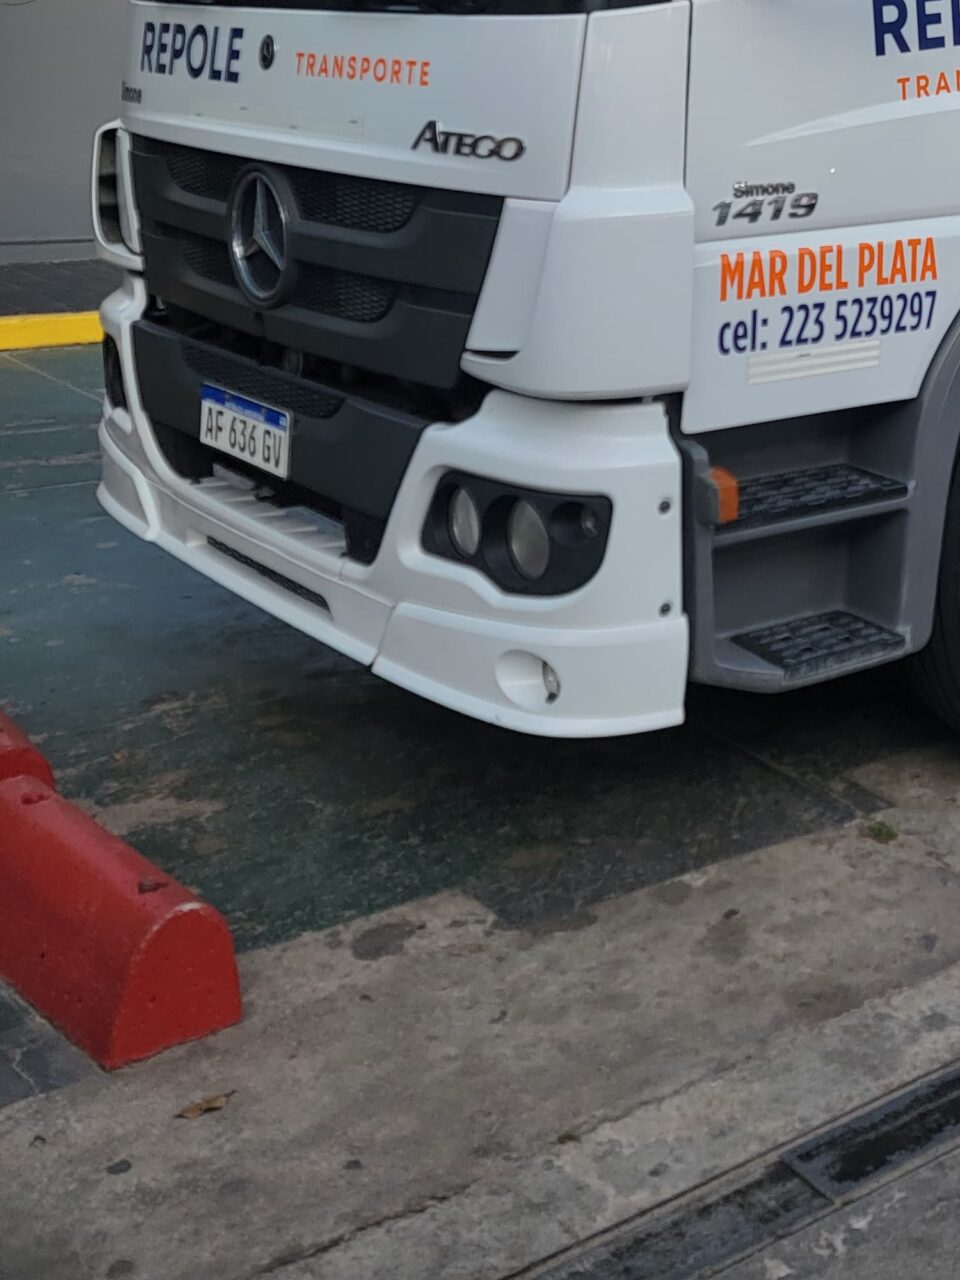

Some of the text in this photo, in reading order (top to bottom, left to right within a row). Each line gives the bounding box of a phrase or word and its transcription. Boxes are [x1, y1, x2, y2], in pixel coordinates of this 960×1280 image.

[140, 21, 431, 87] REPOLE TRANSPORTE
[712, 192, 819, 227] 1419
[733, 181, 796, 199] Simone
[719, 237, 938, 303] MAR DEL PLATA
[718, 290, 938, 356] cel: 223 5239297
[205, 407, 224, 442] AF
[228, 417, 257, 458] 636
[262, 429, 282, 468] GV
